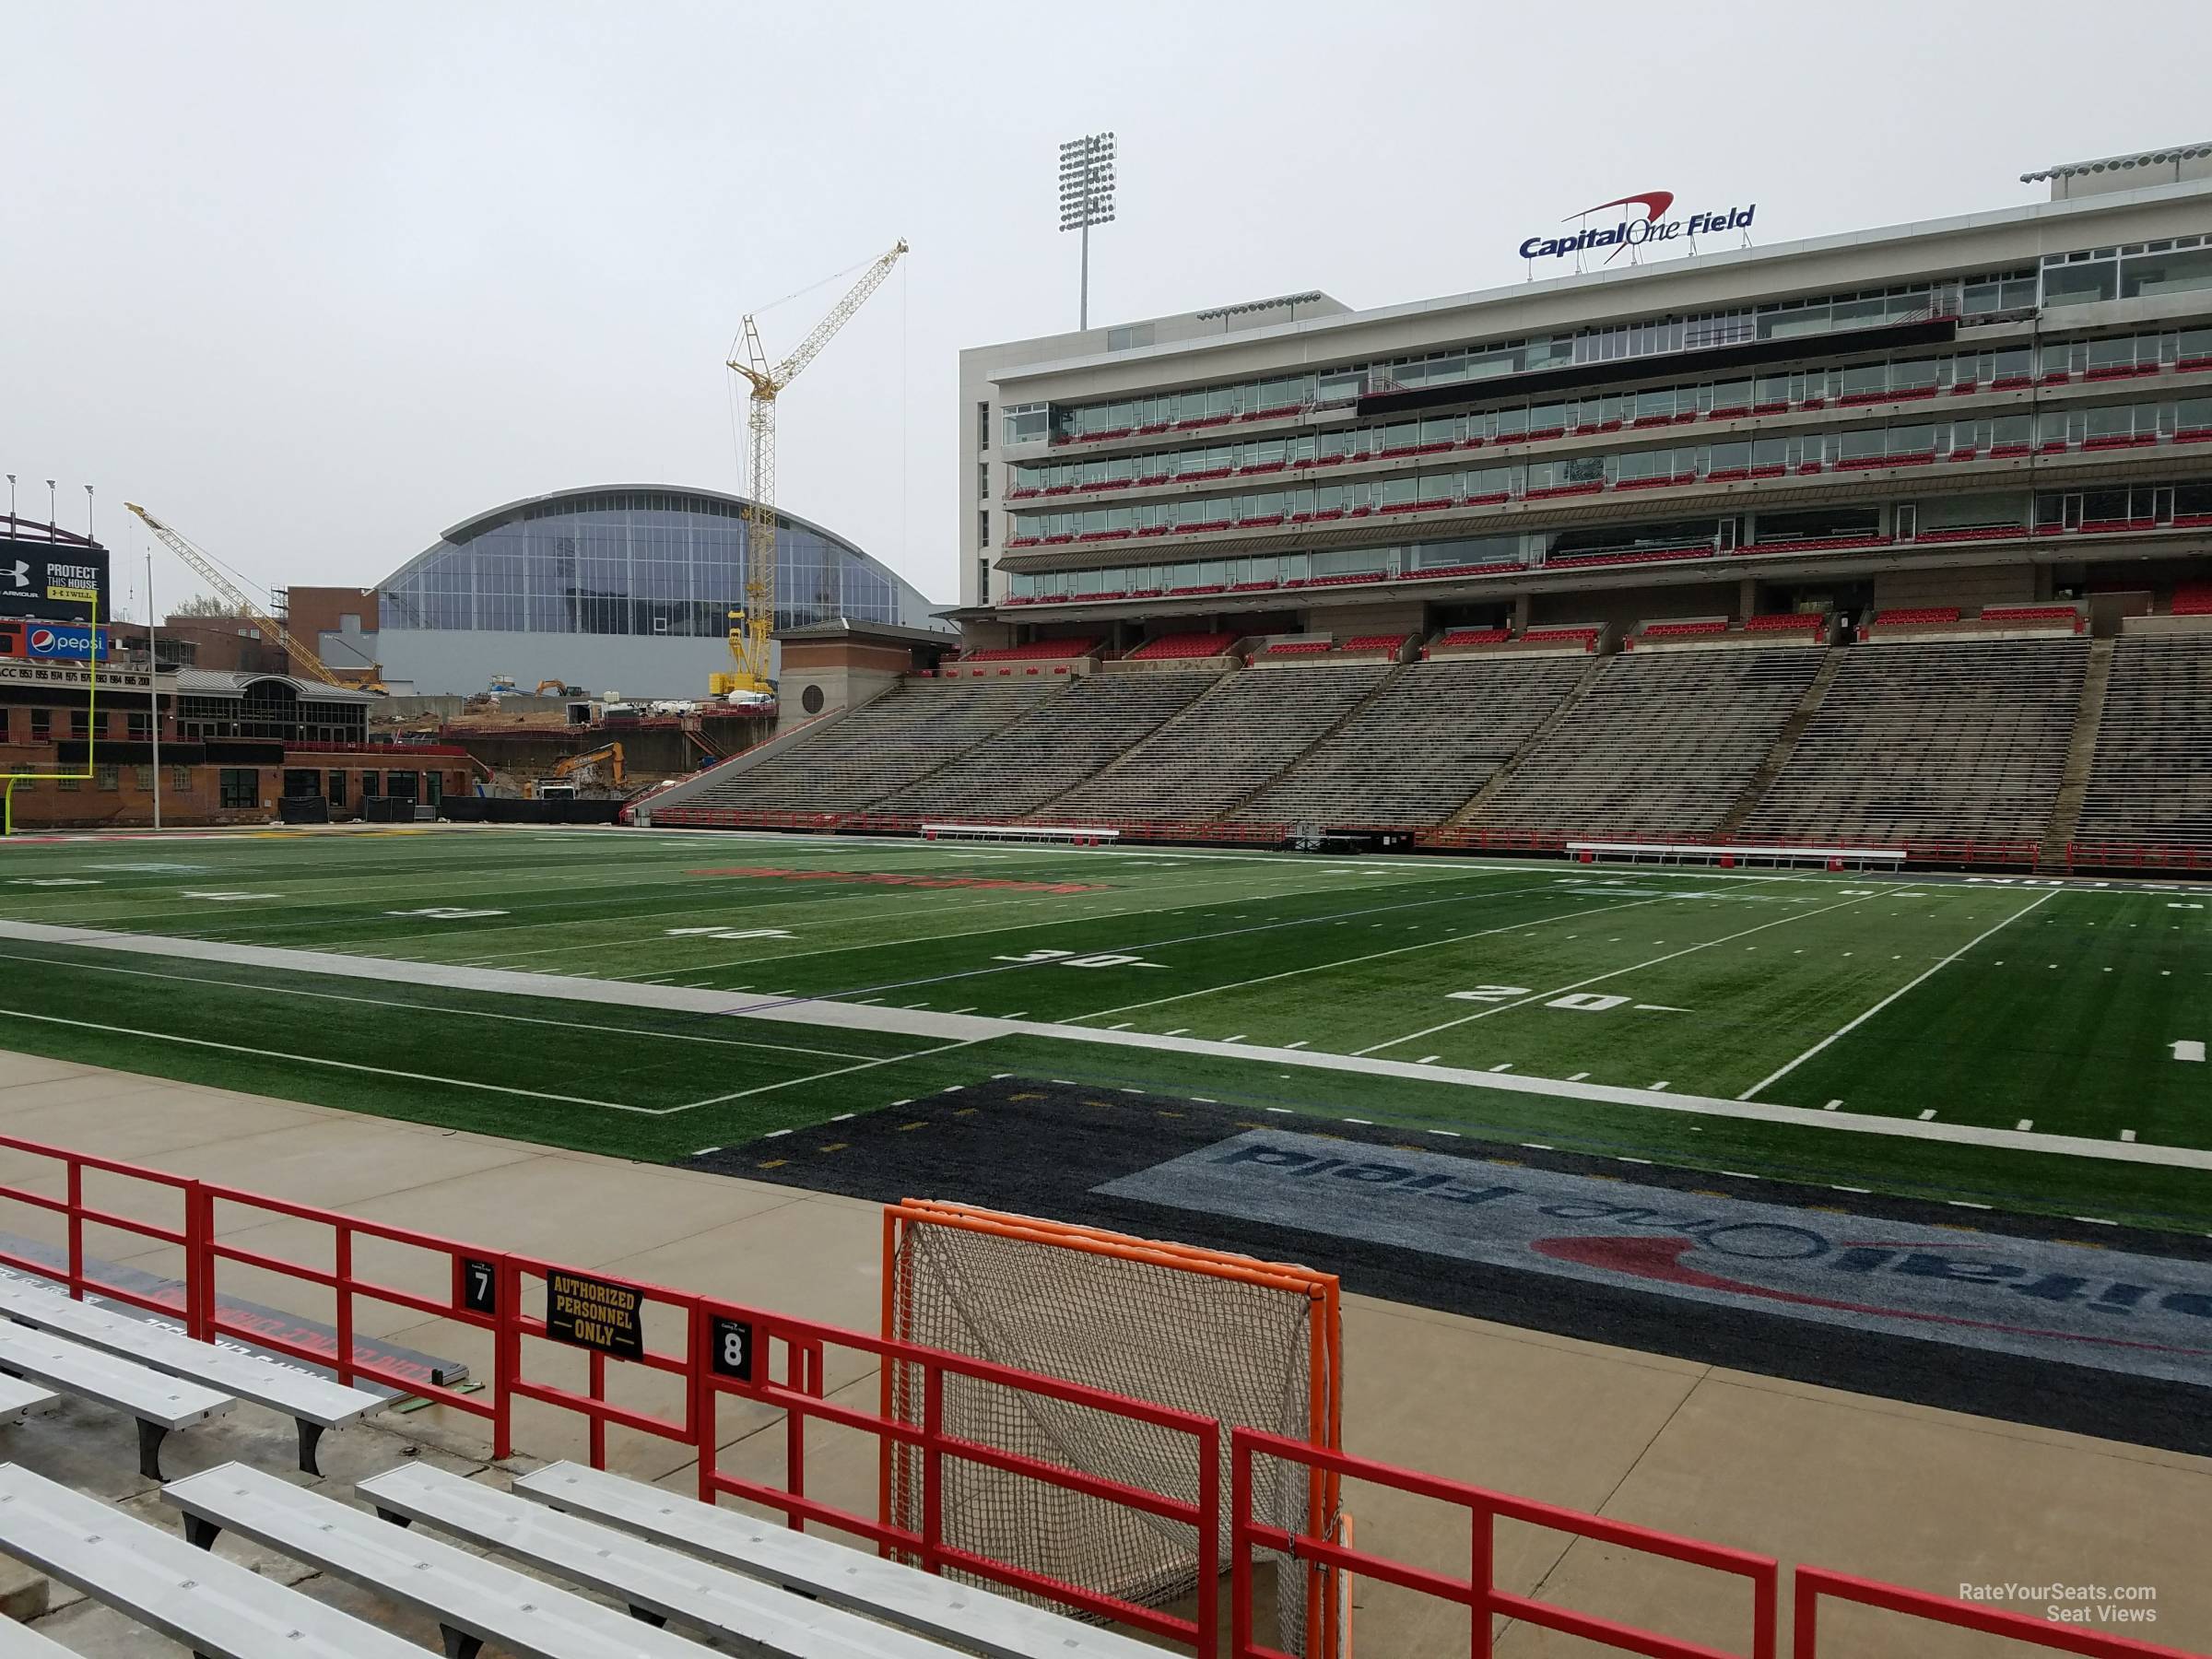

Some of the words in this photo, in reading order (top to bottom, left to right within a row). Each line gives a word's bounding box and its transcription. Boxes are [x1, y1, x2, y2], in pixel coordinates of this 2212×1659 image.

[1687, 204, 1757, 237] Field
[47, 563, 100, 579] PROTECT
[47, 576, 66, 587] THIS
[3, 590, 39, 598] ARMOUR
[57, 637, 103, 653] pepsi
[1211, 1144, 1524, 1206] Field
[475, 1271, 488, 1301] 7
[553, 1275, 636, 1312] AUTHORIZED
[556, 1294, 633, 1330] PERSONNEL
[574, 1319, 616, 1347] ONLY
[724, 1333, 742, 1366] 8
